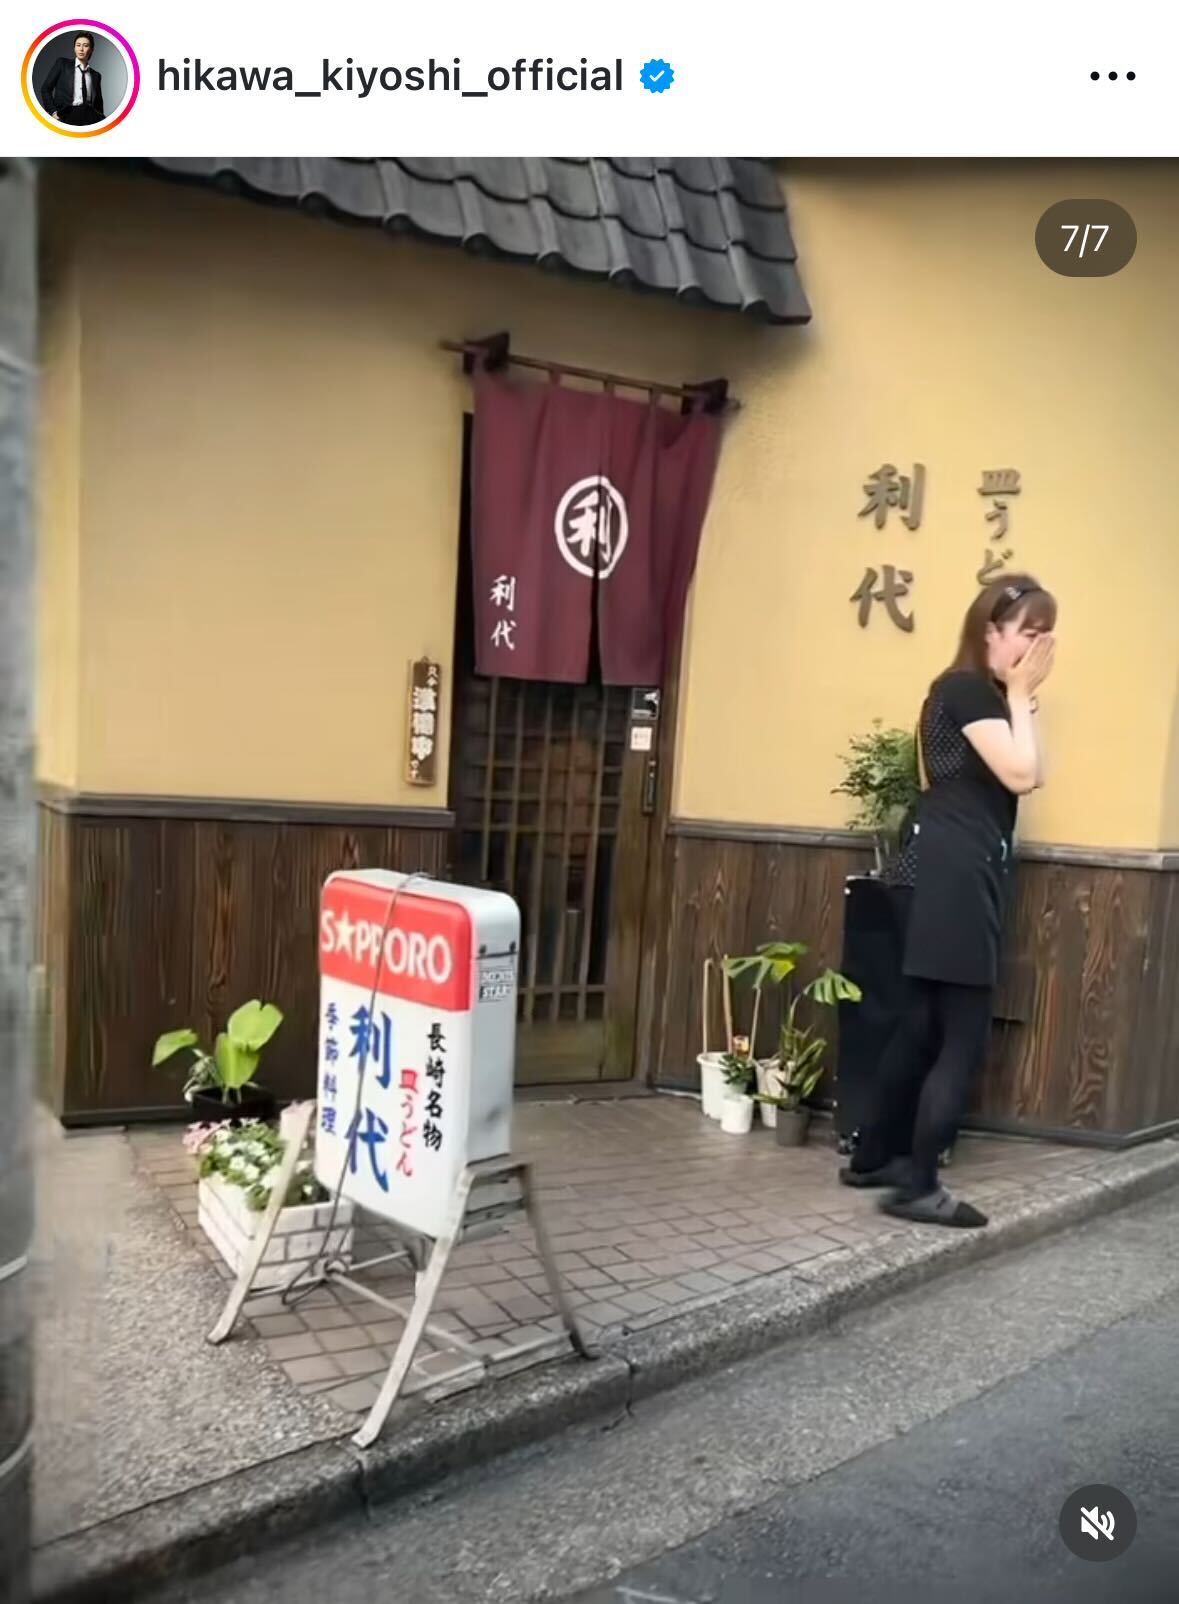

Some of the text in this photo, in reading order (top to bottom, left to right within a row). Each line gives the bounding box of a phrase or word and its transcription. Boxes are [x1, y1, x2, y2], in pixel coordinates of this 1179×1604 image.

[489, 574, 518, 651] 利代
[848, 462, 927, 634] 利代
[343, 1004, 392, 1193] 利代
[423, 1022, 447, 1152] 長崎名物
